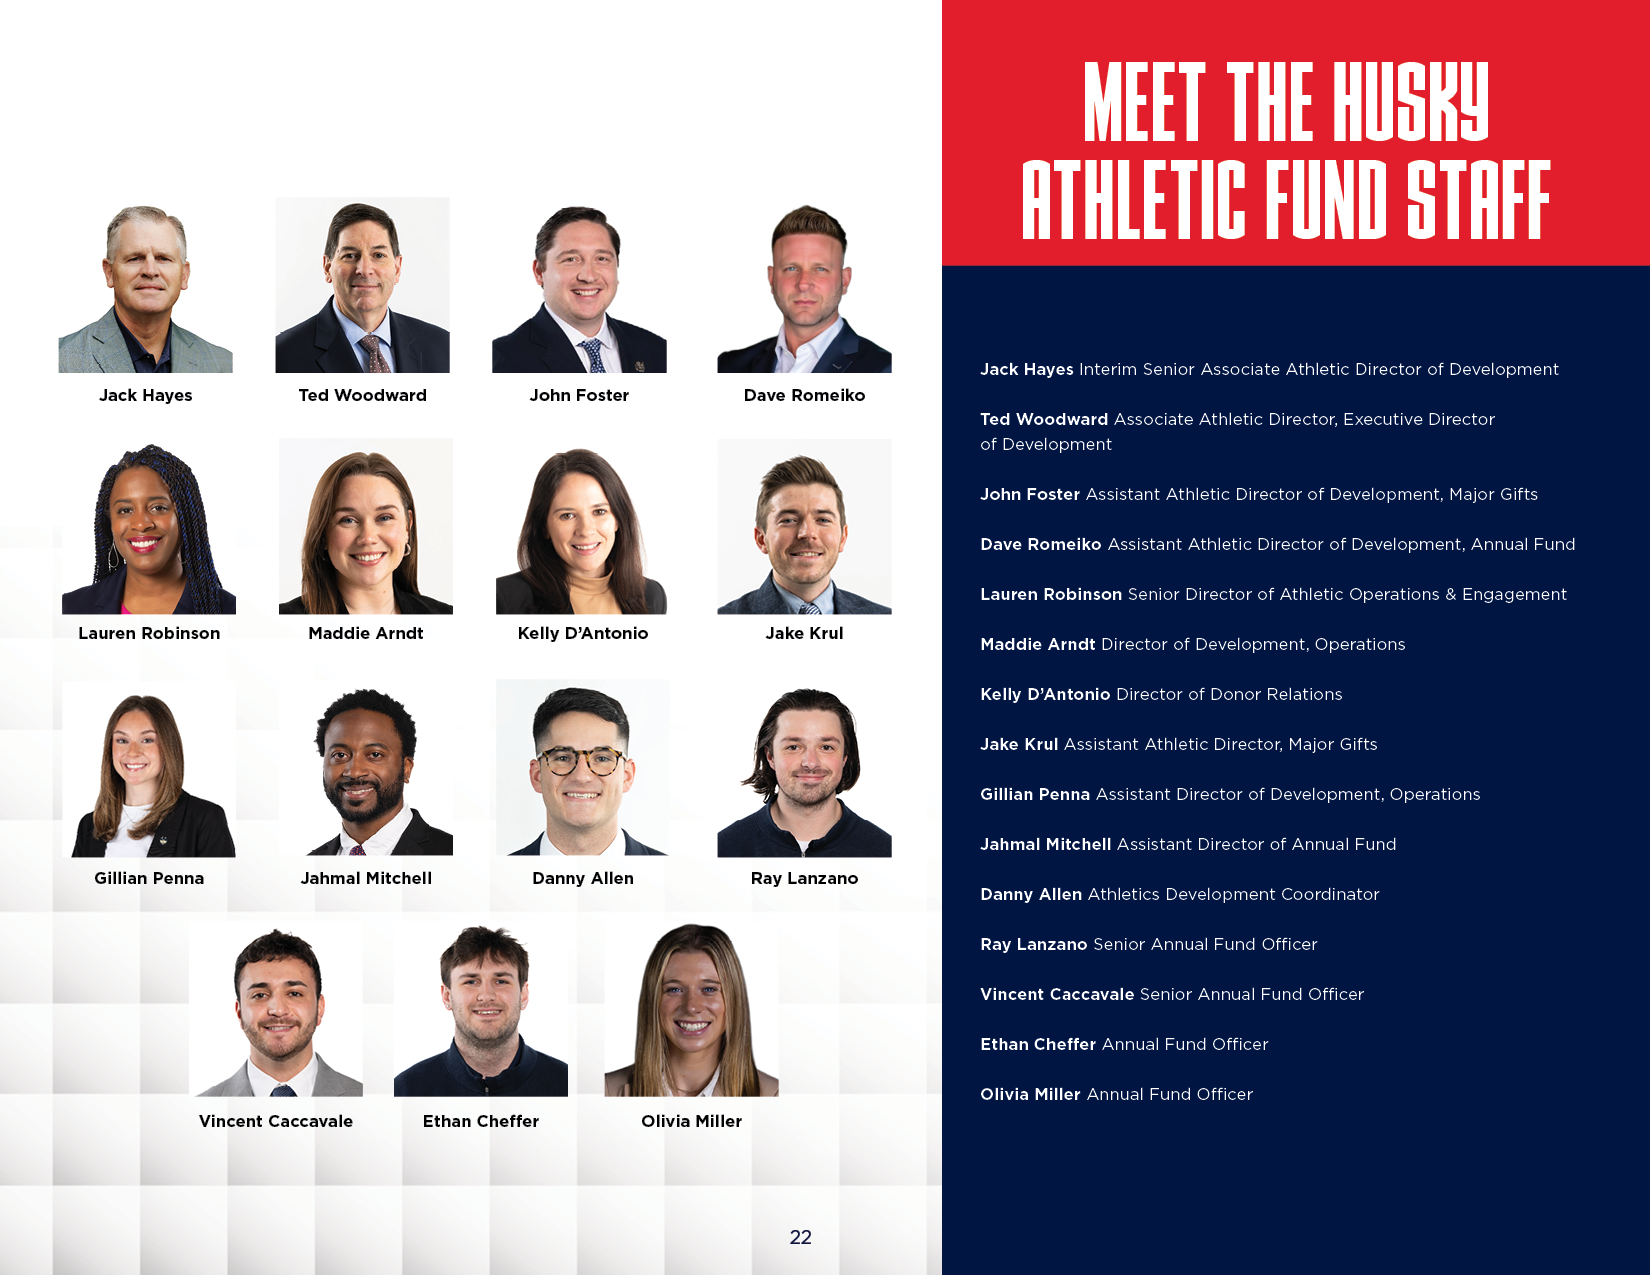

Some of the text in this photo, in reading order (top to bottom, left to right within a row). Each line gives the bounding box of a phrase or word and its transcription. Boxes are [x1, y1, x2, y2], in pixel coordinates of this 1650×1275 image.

[1084, 61, 1489, 142] MEET THE HUSKY
[1022, 159, 1552, 240] ATHLETIC FUND STAFF
[980, 362, 1560, 379] Jack Hayes Interim Senior Associate Athletic Director of Development
[98, 388, 193, 405] Jack Hayes
[298, 388, 427, 402] Ted Woodward
[529, 388, 630, 402] John Foster
[744, 388, 866, 402] Dave Romeiko
[980, 412, 1496, 428] Ted Woodward Associate Athletic Director, Executive Director
[980, 437, 1113, 454] of Development
[980, 487, 1538, 504] John Foster Assistant Athletic Director of Development, Major Gifts
[981, 537, 1575, 554] Dave Romeiko Assistant Athletic Director of Development, Annual Fund
[981, 587, 1568, 604] Lauren Robinson Senior Director of Athletic Operations & Engagement
[78, 626, 221, 640] Lauren Robinson
[308, 626, 424, 640] Maddie Arndt
[518, 626, 649, 643] Kelly D’Antonio
[765, 626, 844, 640] Jake Krul
[981, 637, 1406, 654] Maddie Arndt Director of Development, Operations
[981, 687, 1343, 704] Kelly D’Antonio Director of Donor Relations
[980, 737, 1378, 754] Jake Krul Assistant Athletic Director, Major Gifts
[980, 787, 1481, 804] Gillian Penna Assistant Director of Development, Operations
[980, 837, 1396, 851] Jahmal Mitchell Assistant Director of Annual Fund
[94, 871, 205, 885] Gillian Penna
[300, 871, 432, 885] Jahmal Mitchell
[532, 871, 634, 888] Danny Allen
[751, 871, 859, 888] Ray Lanzano
[981, 887, 1380, 904] Danny Allen Athletics Development Coordinator
[981, 937, 1318, 954] Ray Lanzano Senior Annual Fund Officer
[980, 987, 1365, 1001] Vincent Caccavale Senior Annual Fund Officer
[981, 1037, 1269, 1051] Ethan Cheffer Annual Fund Officer
[980, 1087, 1254, 1101] Olivia Miller Annual Fund Officer
[198, 1114, 354, 1128] Vincent Caccavale
[423, 1114, 540, 1128] Ethan Cheffer
[641, 1114, 743, 1128] Olivia Miller
[789, 1229, 812, 1245] 22
